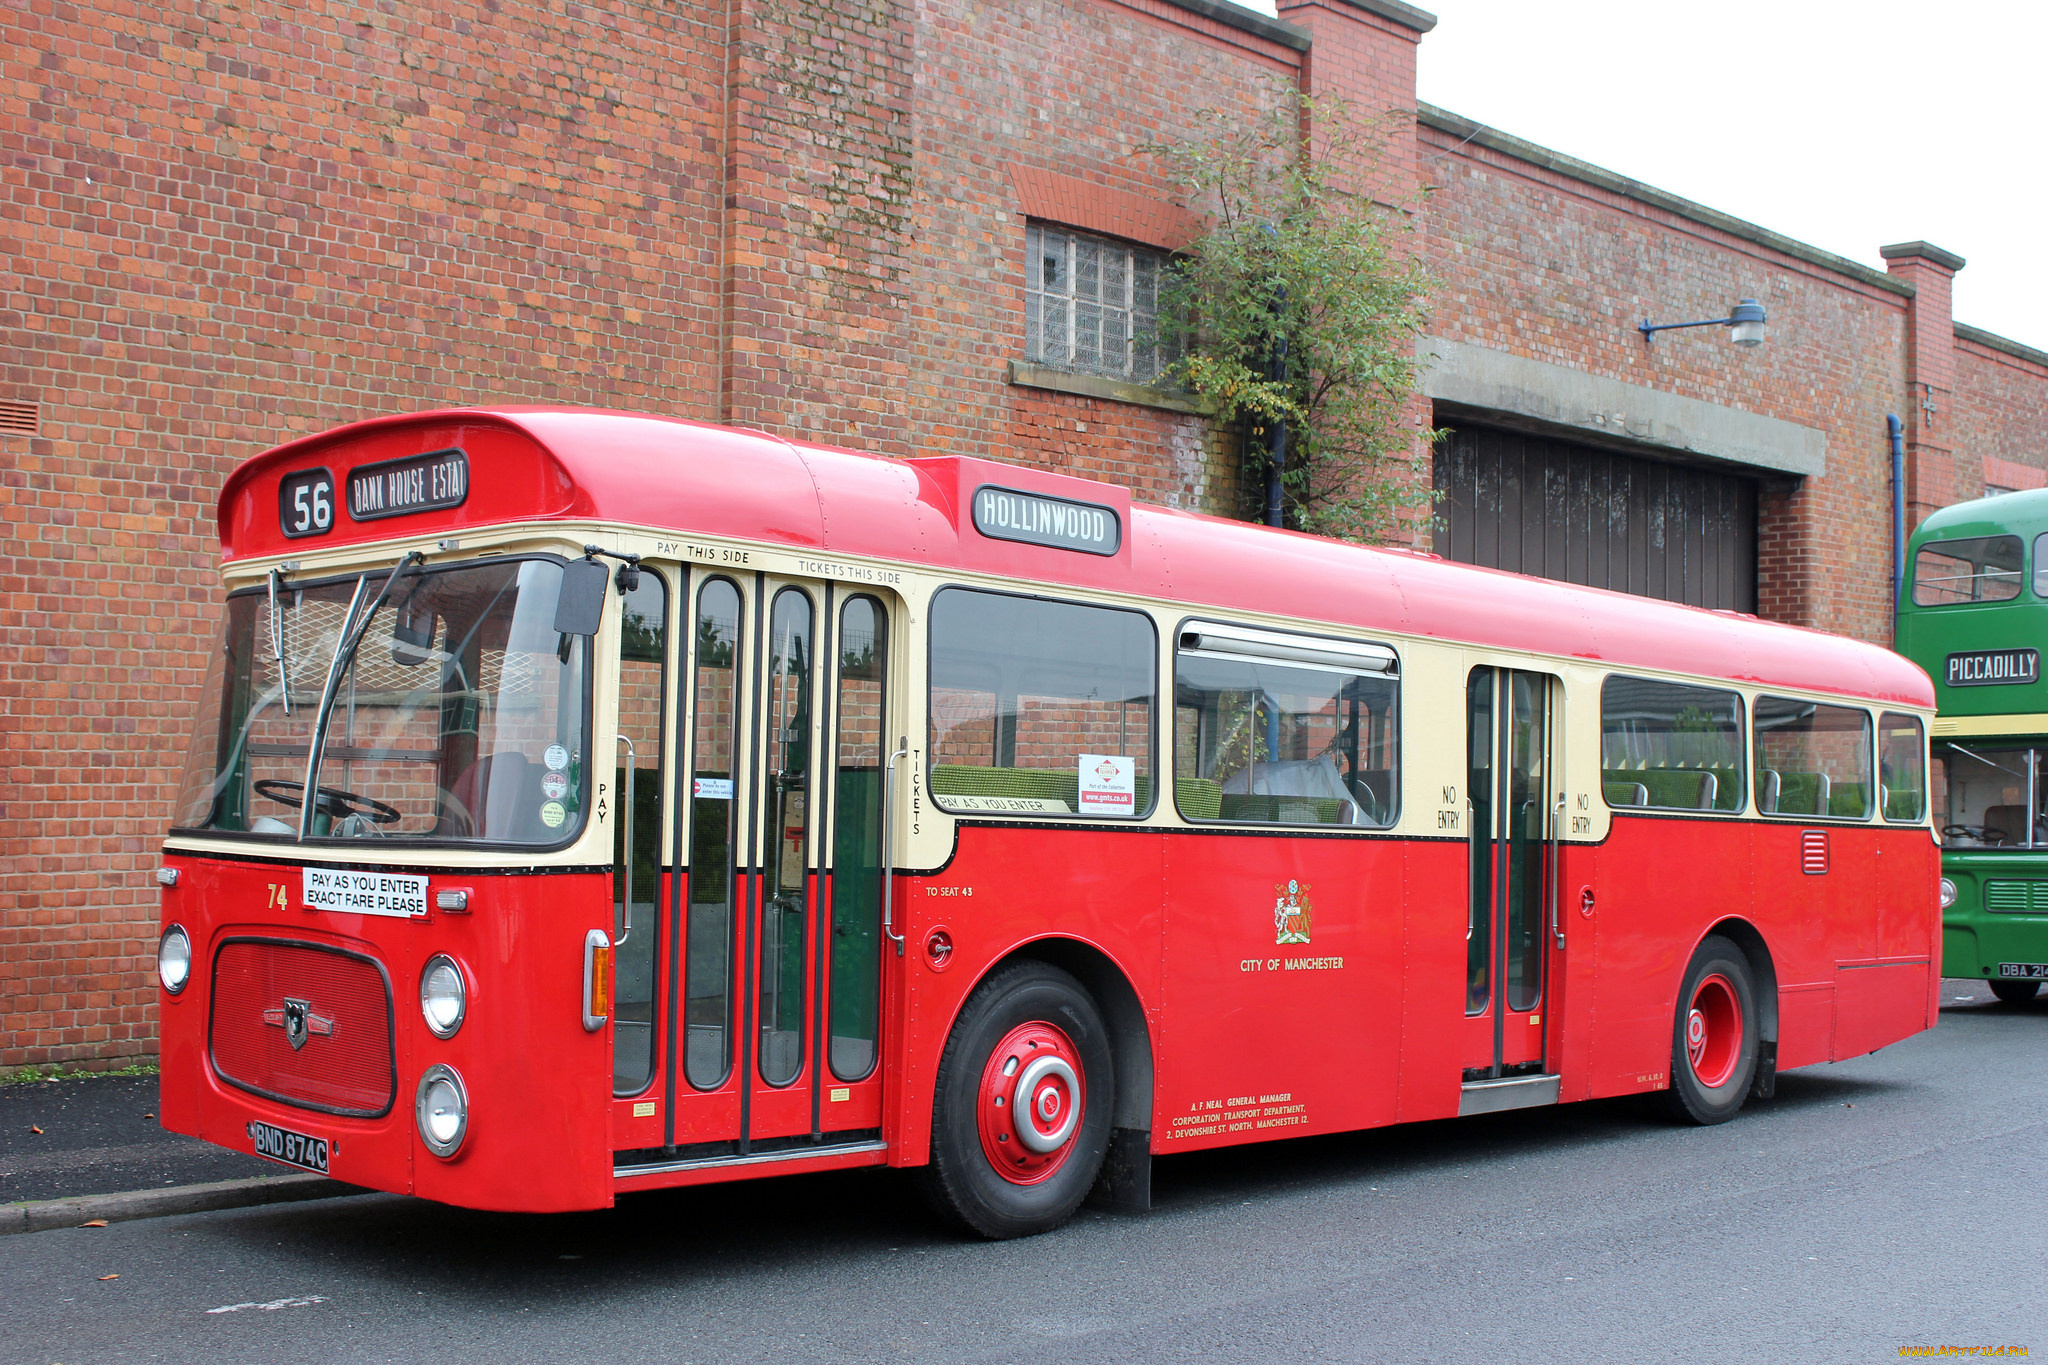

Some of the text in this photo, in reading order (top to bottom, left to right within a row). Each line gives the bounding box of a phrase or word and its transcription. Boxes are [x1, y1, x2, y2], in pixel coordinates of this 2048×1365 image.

[354, 475, 383, 512] BANK
[389, 468, 424, 507] HOUSE
[294, 482, 331, 531] 56
[983, 492, 1104, 542] HOLLINWOOD
[657, 542, 749, 563] PAY THIS SIDE
[799, 560, 900, 583] TICKETS THIS SIDE
[1949, 653, 2036, 680] PICCADILLY
[598, 784, 607, 823] PAY
[939, 797, 1045, 811] PAY AS YOU ENTER
[1086, 794, 1128, 802] www.gmts.co.uk
[1443, 786, 1456, 804] NO
[1577, 793, 1589, 811] NO
[1438, 811, 1460, 829] ENTRY
[1572, 816, 1591, 834] ENTRY
[312, 874, 419, 894] PAY AS YOU ENTER
[926, 887, 972, 896] TO SEAT 43
[268, 884, 288, 910] 74
[308, 890, 423, 912] EXACT FARE PLEASE
[1240, 957, 1344, 972] CITY OF MANCHESTER
[2002, 965, 2028, 976] DBA
[1206, 1100, 1222, 1110] NEAL
[1227, 1096, 1256, 1106] GENERAL
[1260, 1093, 1291, 1104] MANAGER
[1172, 1114, 1220, 1126] CORPORATION
[1224, 1109, 1260, 1120] TRANSPORT
[1175, 1126, 1216, 1138] DEVONSHIRE
[1257, 1116, 1298, 1128] MANCHESTER
[256, 1124, 326, 1168] BND 874C
